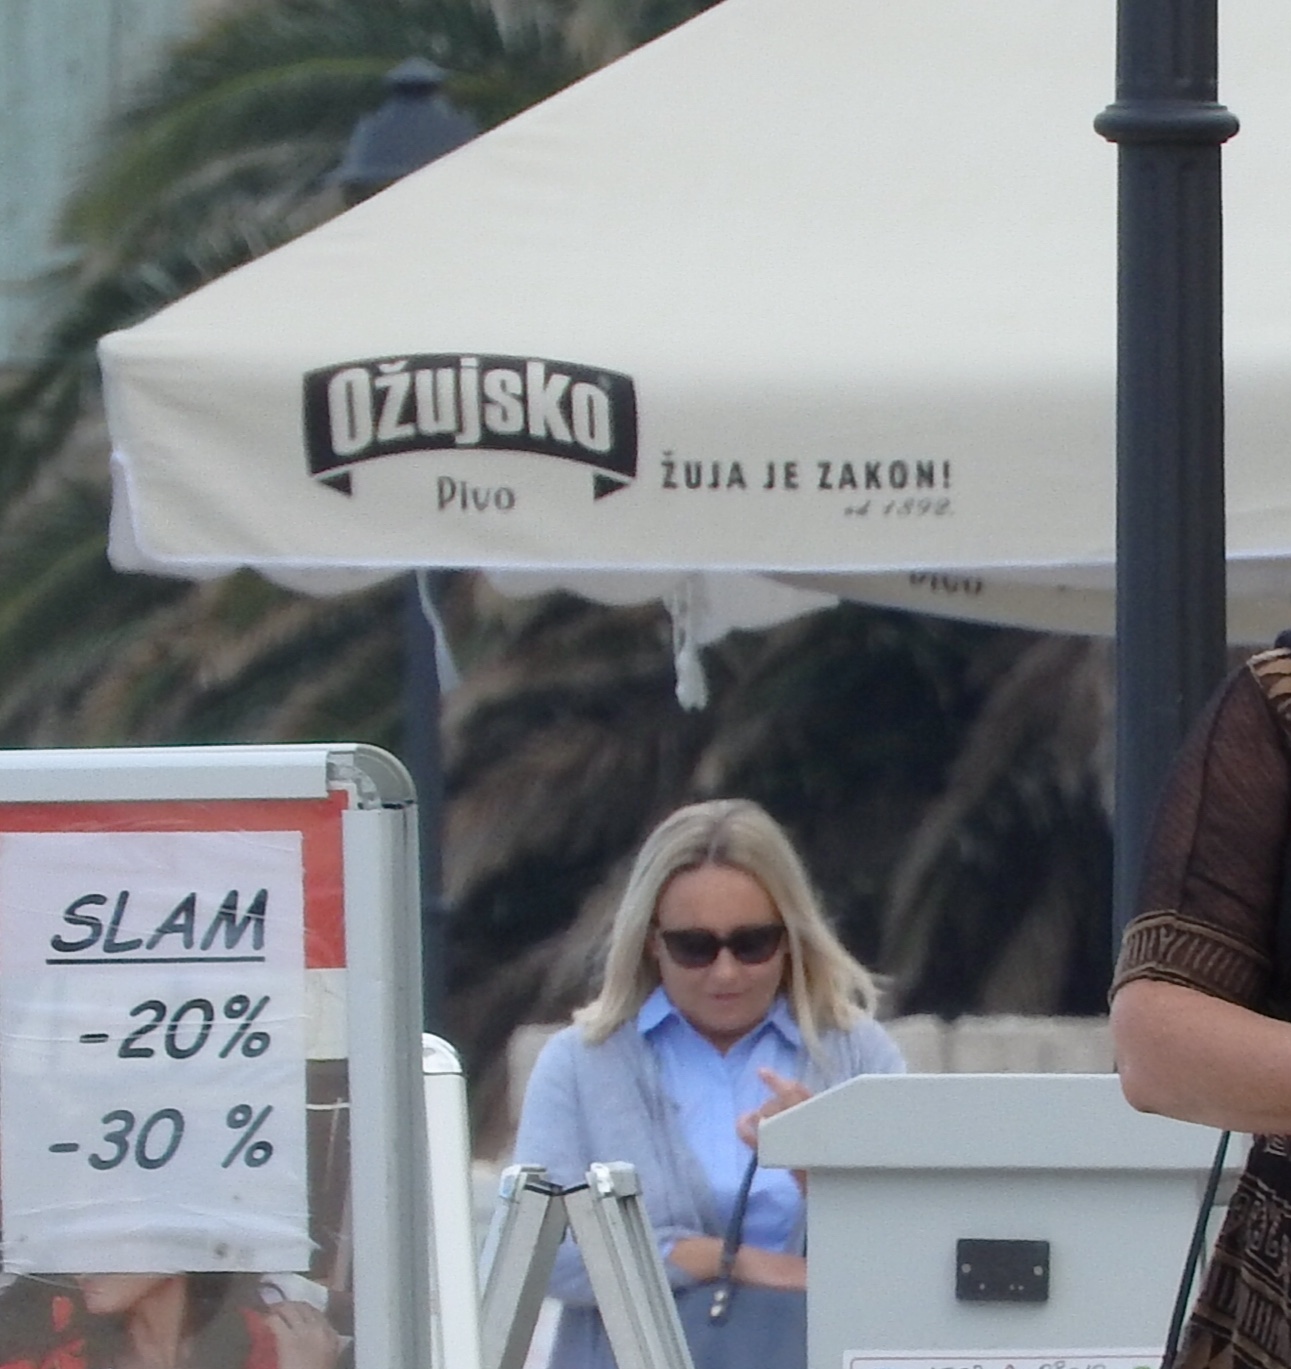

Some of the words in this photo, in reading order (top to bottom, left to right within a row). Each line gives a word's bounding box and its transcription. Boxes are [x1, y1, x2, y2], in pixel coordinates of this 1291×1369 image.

[328, 356, 612, 457] Ožujsko
[437, 476, 516, 511] Pivo
[661, 450, 747, 489] ŽUJA
[763, 460, 799, 489] JE
[817, 459, 951, 490] ZAKON!
[51, 887, 269, 953] SLAM
[79, 994, 271, 1059] -20%
